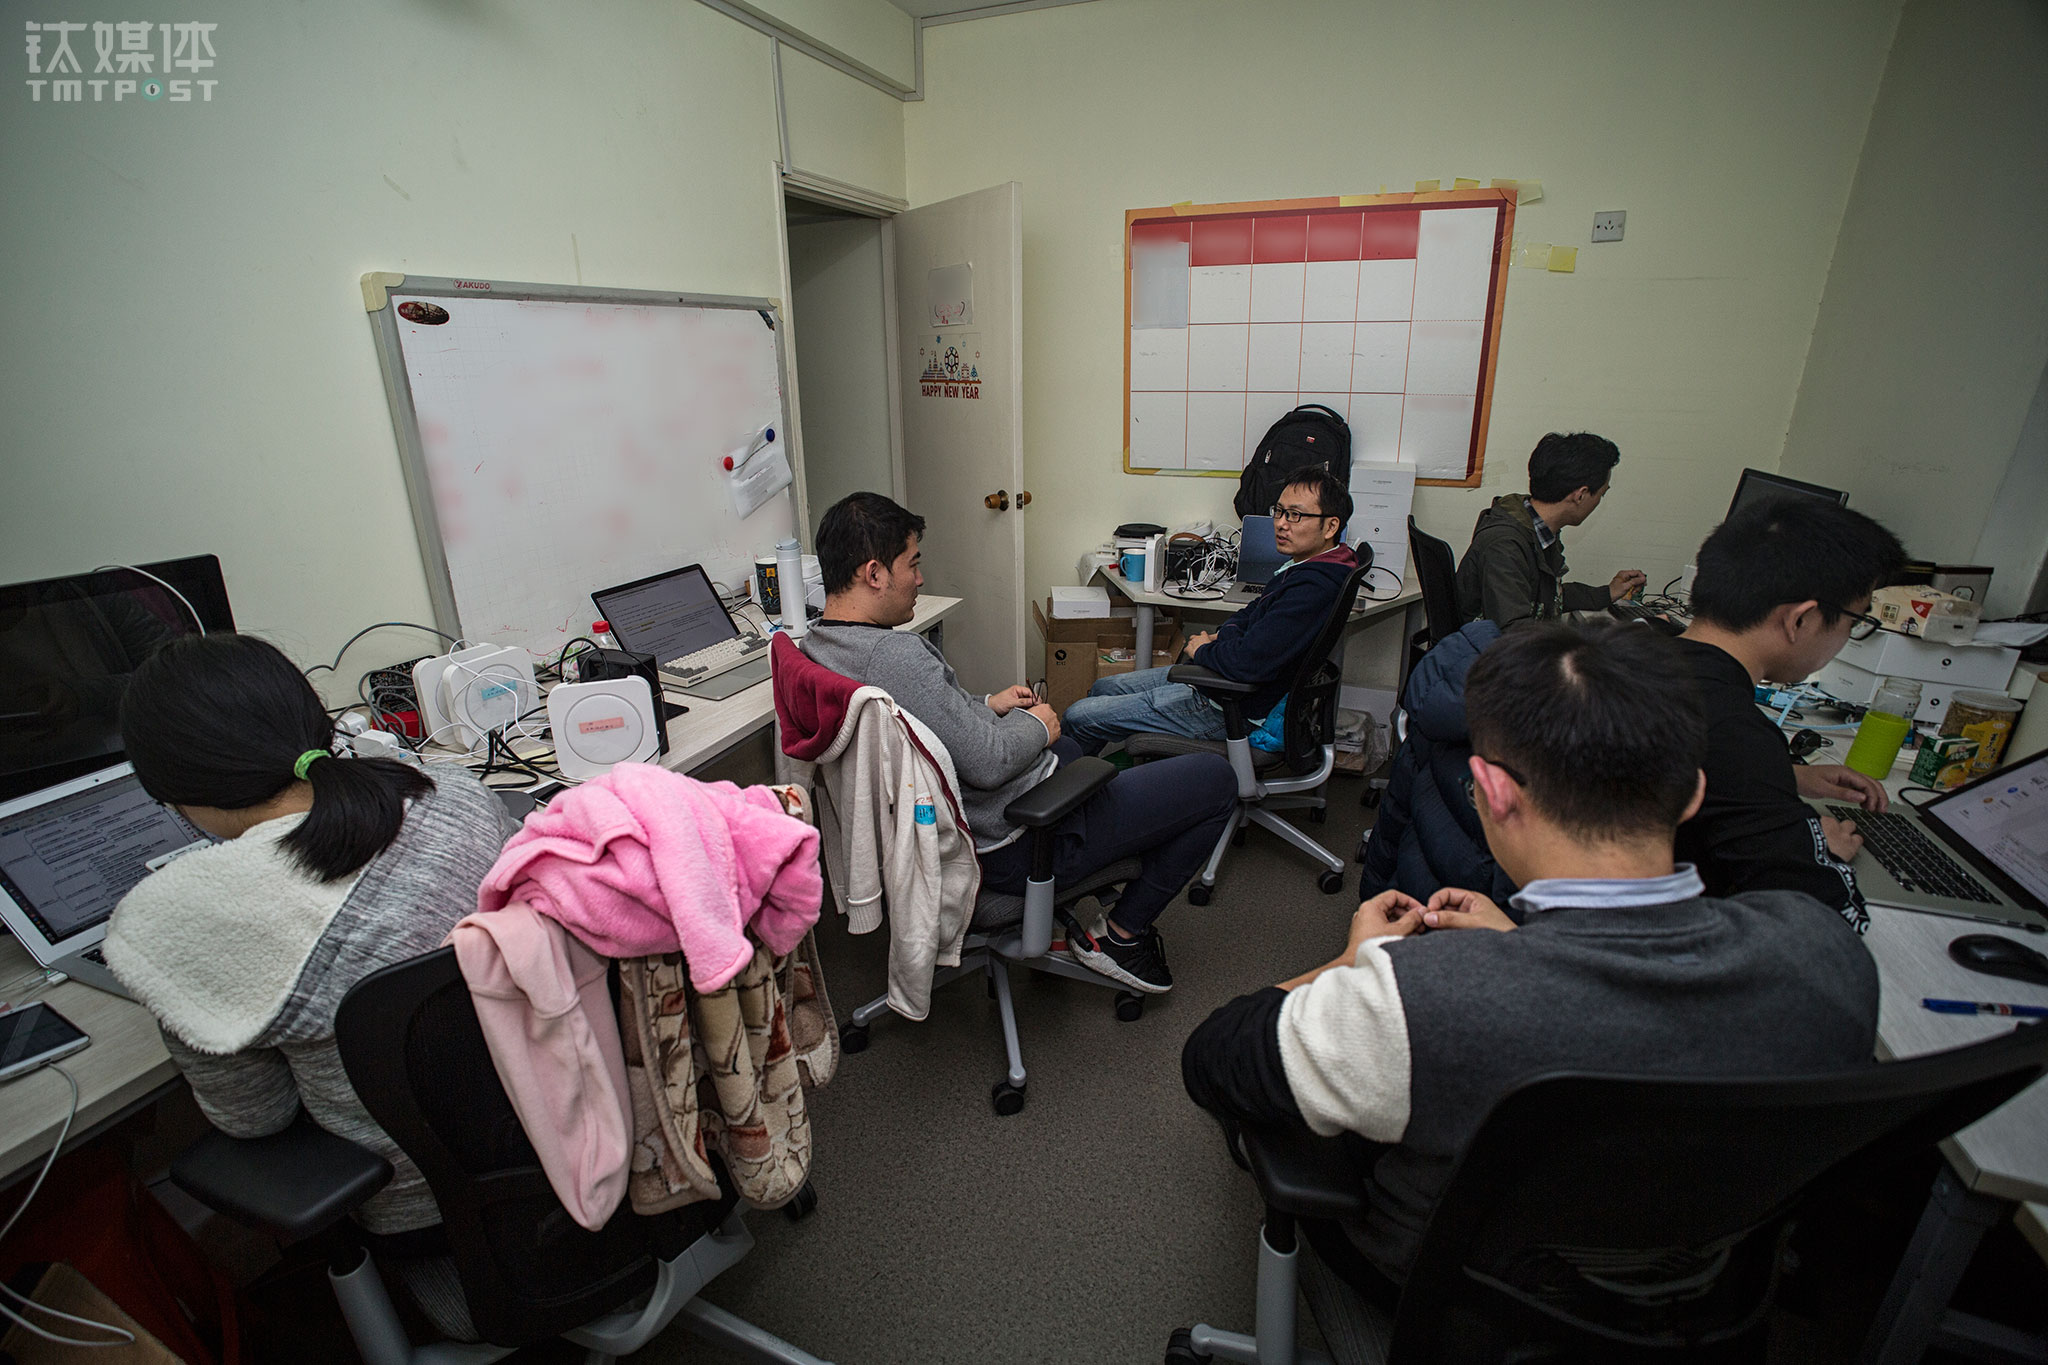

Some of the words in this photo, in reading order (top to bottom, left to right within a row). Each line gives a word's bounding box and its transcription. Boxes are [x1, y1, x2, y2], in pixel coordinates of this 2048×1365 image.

[921, 384, 942, 397] HAPPY
[944, 385, 959, 398] NEW
[961, 386, 979, 399] YEAR
